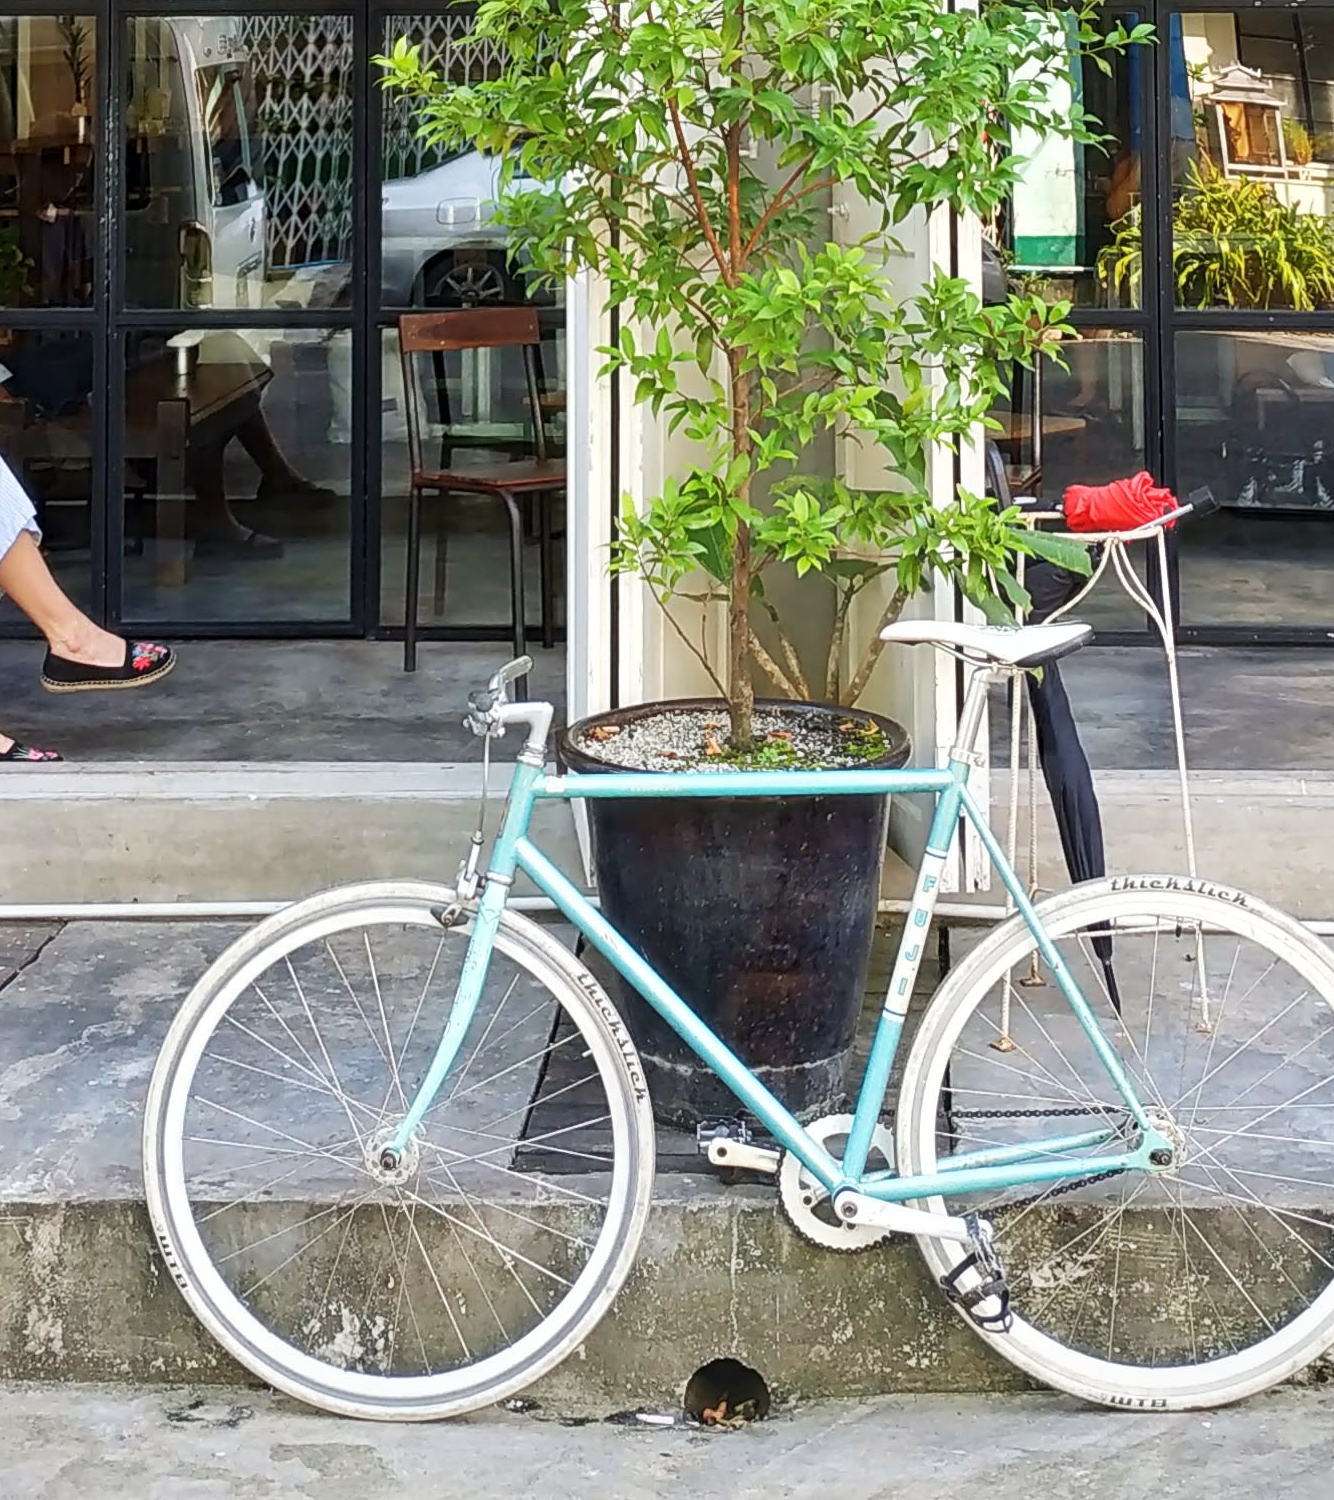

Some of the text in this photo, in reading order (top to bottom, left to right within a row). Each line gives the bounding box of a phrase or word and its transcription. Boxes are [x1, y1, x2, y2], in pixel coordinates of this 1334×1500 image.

[1110, 875, 1250, 908] thickslick
[897, 873, 938, 996] FUJI
[576, 971, 648, 1104] thickslick
[1109, 1395, 1168, 1408] WTB
